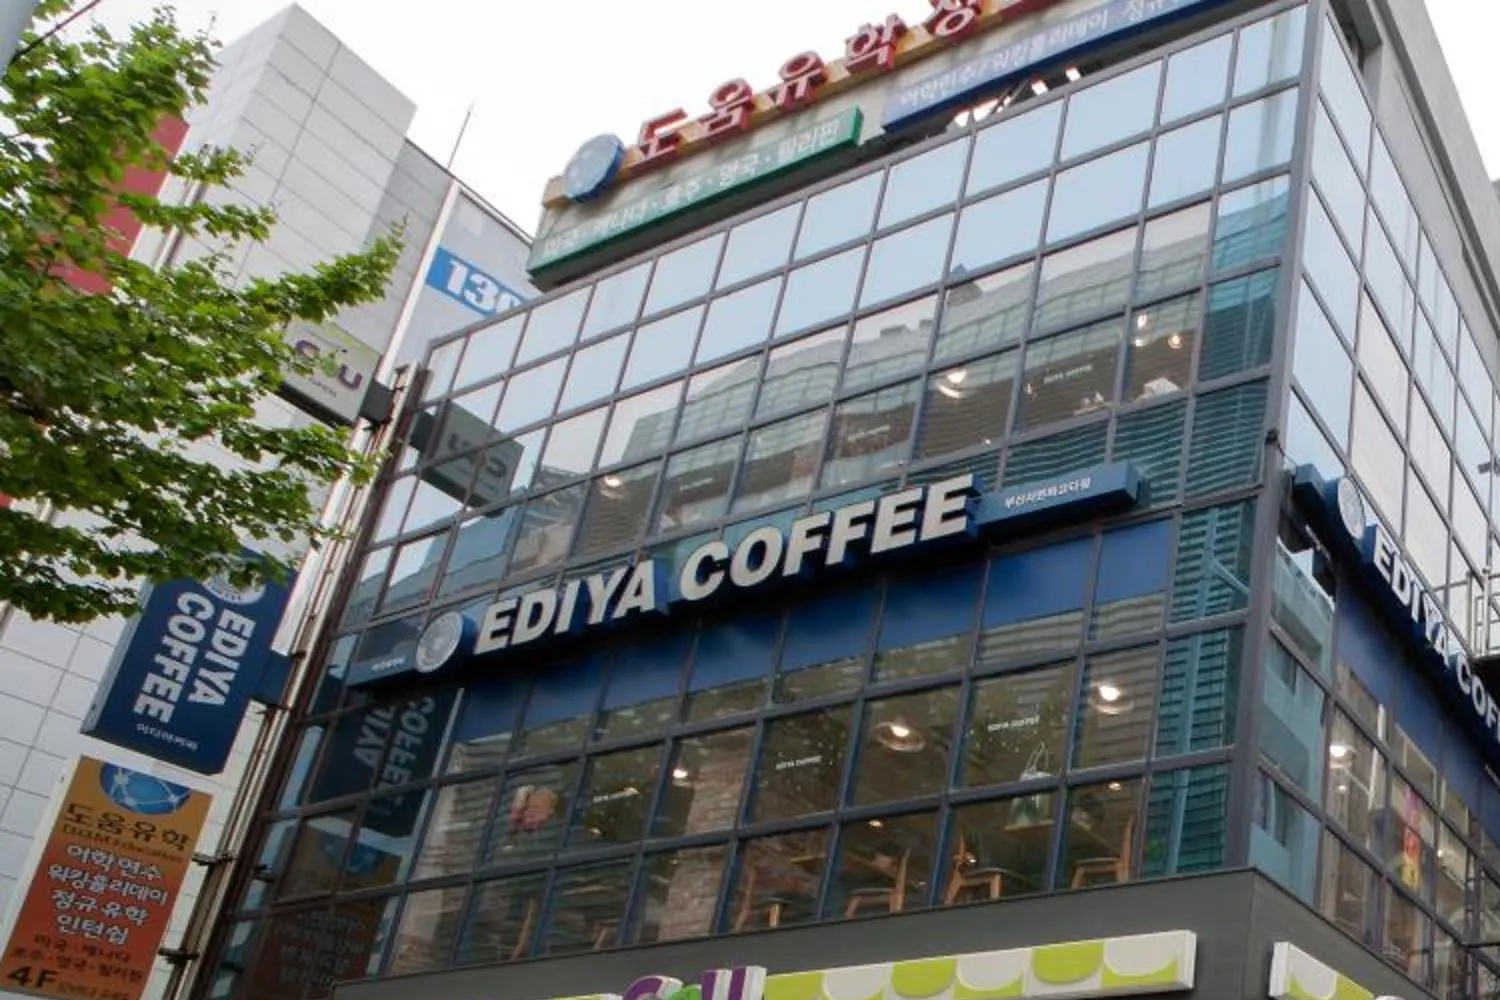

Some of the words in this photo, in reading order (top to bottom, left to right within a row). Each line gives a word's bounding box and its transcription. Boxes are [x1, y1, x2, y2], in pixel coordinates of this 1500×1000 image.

[474, 559, 657, 655] EDIYA
[679, 474, 976, 602] COFFEE
[1374, 525, 1451, 670] EDIYA
[132, 591, 215, 724] COFFEE
[187, 608, 257, 706] EDIYA
[6, 965, 60, 988] 4F
